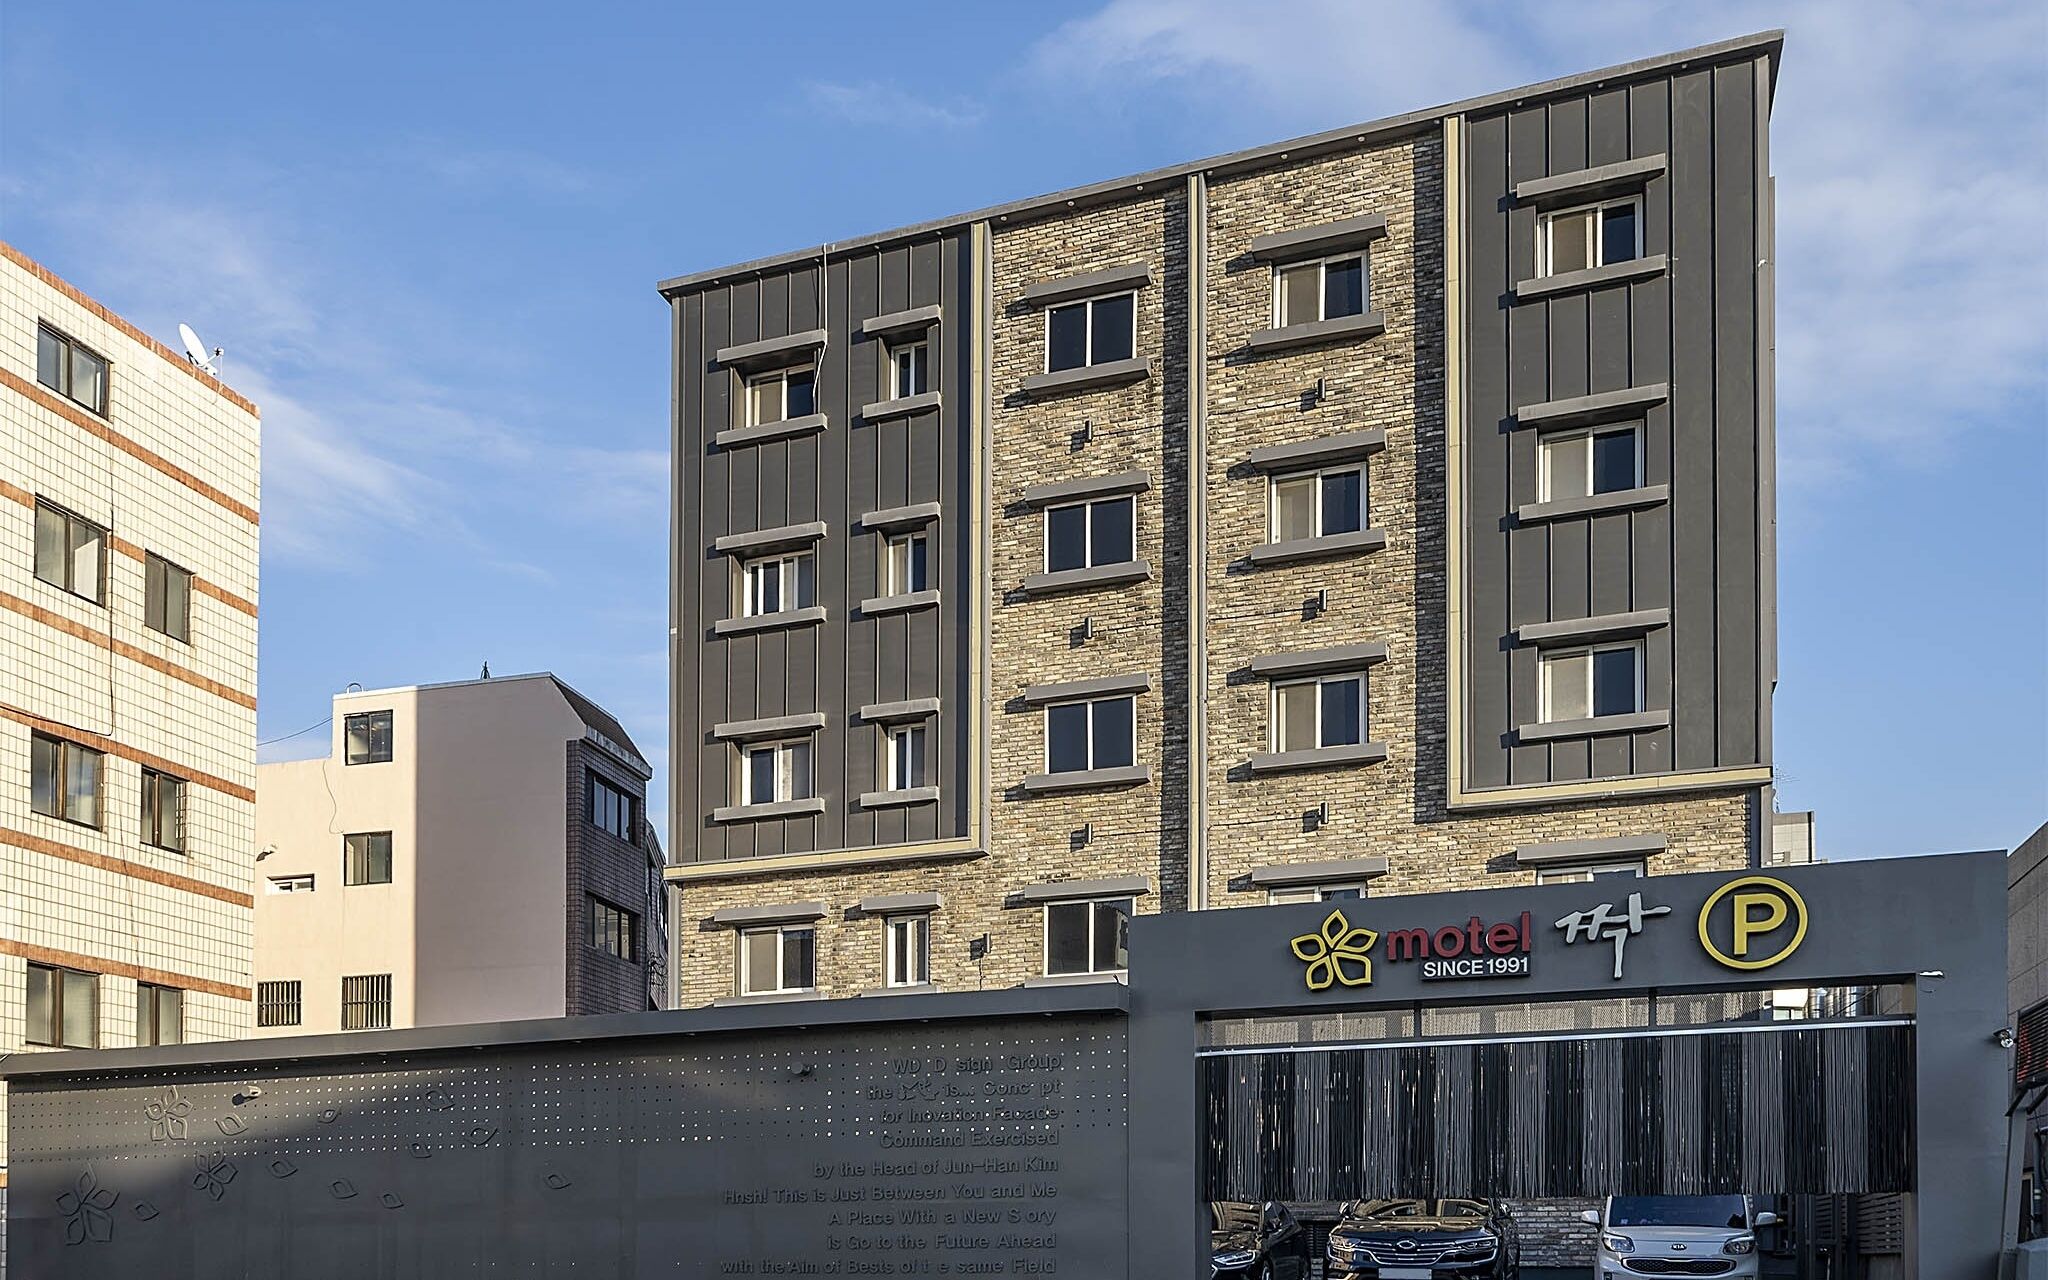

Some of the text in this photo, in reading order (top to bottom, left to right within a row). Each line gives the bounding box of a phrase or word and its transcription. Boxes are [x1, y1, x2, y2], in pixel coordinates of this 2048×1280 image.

[1734, 894, 1788, 955] P
[1387, 910, 1532, 961] motel
[1423, 957, 1529, 978] SINCE 1991
[1007, 1054, 1062, 1071] Group
[983, 1080, 1061, 1097] Concpt
[880, 1127, 1060, 1149] Command Exercised
[814, 1163, 833, 1180] by
[839, 1161, 865, 1177] the
[872, 1159, 916, 1176] Head
[922, 1159, 940, 1175] of
[1024, 1156, 1059, 1172] Kim
[772, 1187, 808, 1203] This
[814, 1187, 825, 1202] is
[831, 1185, 866, 1201] Just
[872, 1182, 946, 1200] Between
[952, 1183, 985, 1198] You
[991, 1183, 1025, 1198] and
[1031, 1181, 1057, 1198] Me
[829, 1211, 842, 1226] A
[848, 1209, 894, 1225] Place
[900, 1207, 937, 1224] With
[944, 1211, 956, 1223] a
[963, 1207, 1001, 1224] New
[828, 1232, 1057, 1250] is Go to the Future Ahead
[721, 1259, 754, 1274] with
[760, 1259, 786, 1274] the
[848, 1258, 895, 1274] Bests
[957, 1261, 1003, 1274] same
[1011, 1257, 1057, 1274] Field
